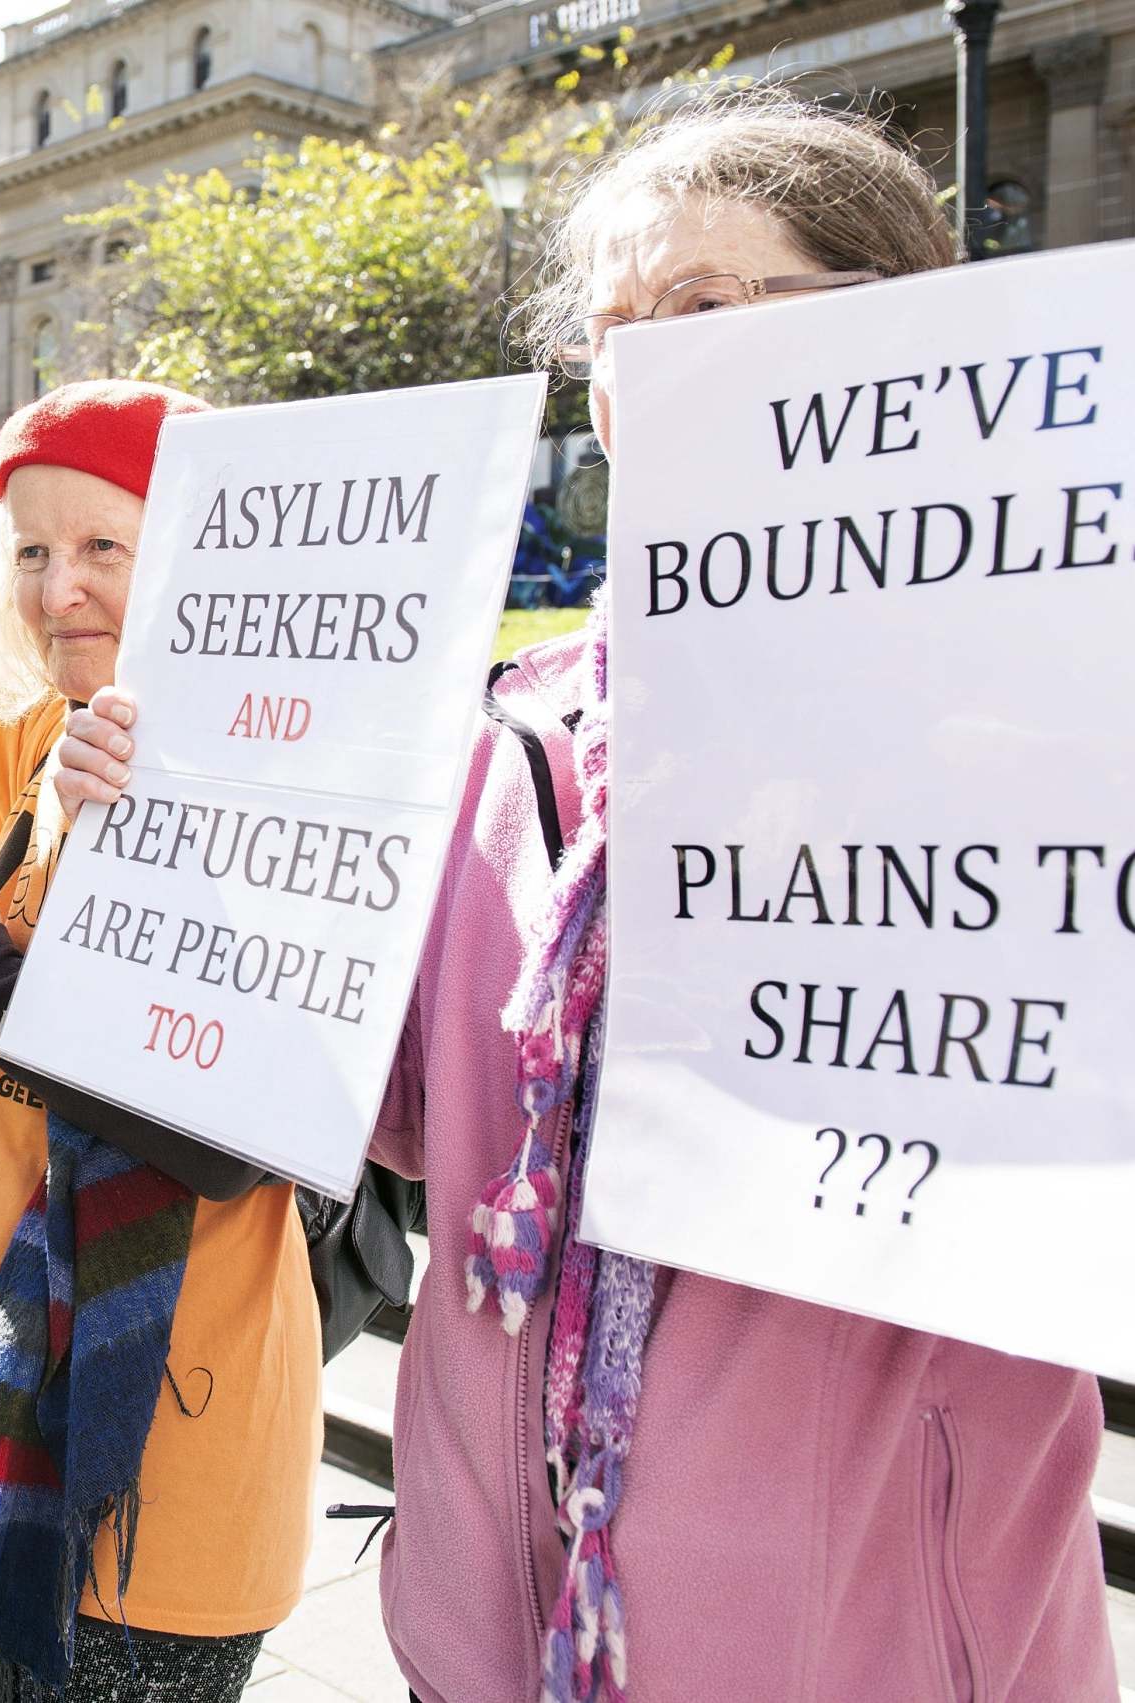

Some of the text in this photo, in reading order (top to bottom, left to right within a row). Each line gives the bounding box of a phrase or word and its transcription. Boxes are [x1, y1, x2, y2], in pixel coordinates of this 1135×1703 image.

[769, 346, 1103, 471] WE'VE
[193, 473, 441, 550] ASYLUM
[645, 482, 1135, 617] BOUNDLE
[170, 593, 427, 663] SEEKERS
[227, 692, 311, 741] AND
[90, 792, 411, 912] REFUGEES
[671, 844, 1001, 931] PLAINS
[60, 894, 376, 1025] ARE PEOPLE
[144, 1003, 225, 1070] TOO
[744, 980, 1067, 1089] SHARE
[814, 1127, 940, 1225] ???
